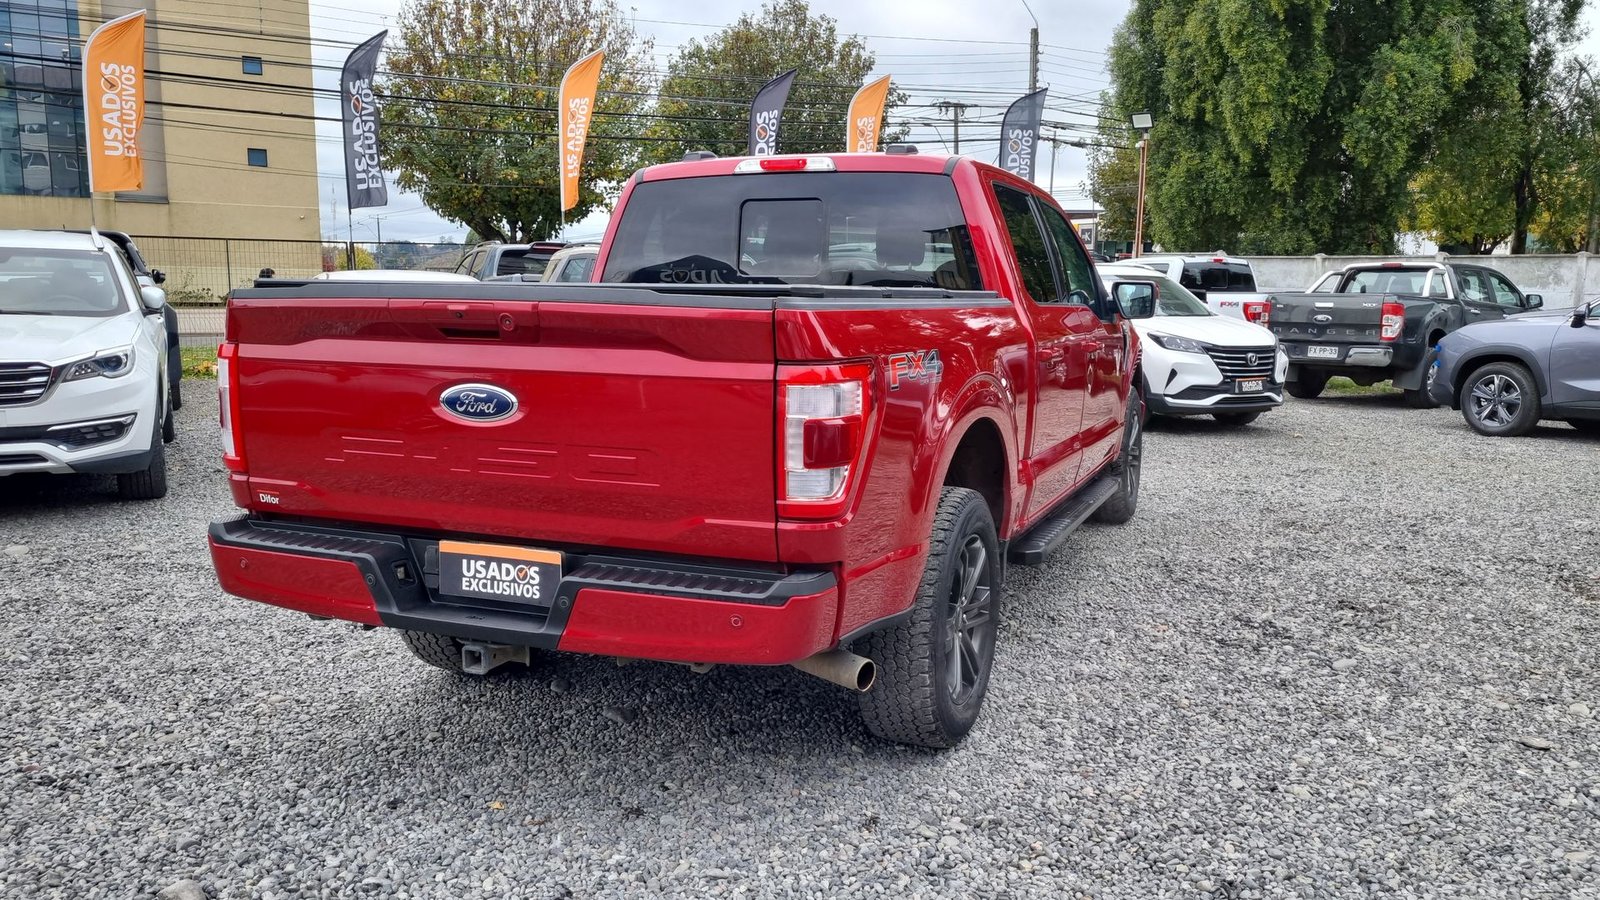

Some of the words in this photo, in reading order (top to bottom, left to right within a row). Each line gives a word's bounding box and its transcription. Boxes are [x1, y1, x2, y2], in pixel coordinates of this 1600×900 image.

[101, 62, 123, 156] USADOS
[121, 65, 137, 157] EXCLUSIVOS
[350, 80, 369, 190] USADOS
[755, 111, 769, 155] DOS
[768, 109, 778, 155] SIVOS
[857, 117, 868, 152] DOS
[866, 116, 876, 152] SIVOS
[1273, 327, 1376, 336] RANGER
[888, 349, 942, 391] FX4
[456, 391, 497, 413] Ford
[259, 493, 279, 504] Difor
[461, 577, 540, 599] EXCLUSIVOS
[462, 558, 540, 584] USADOS
